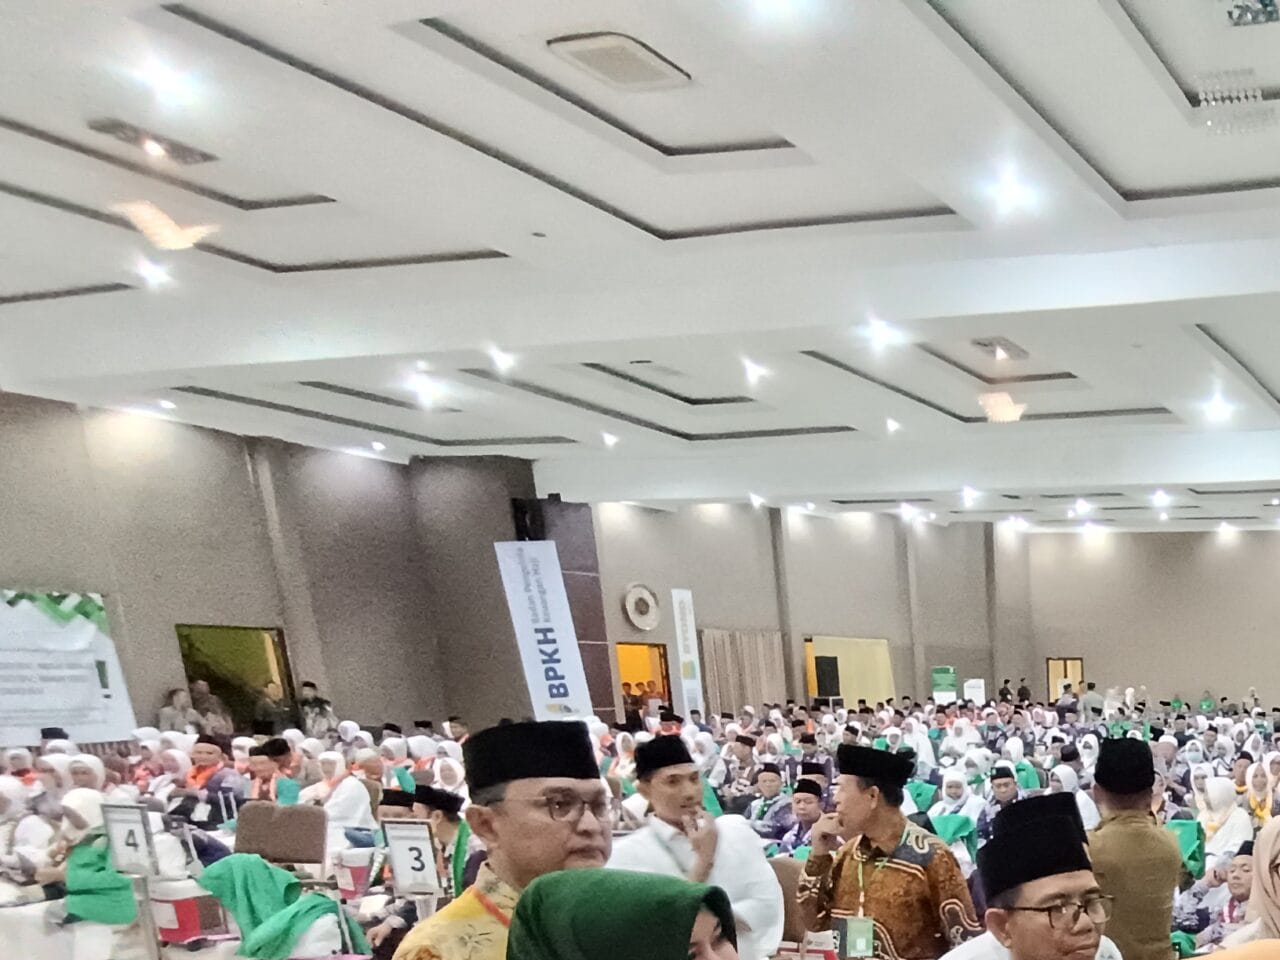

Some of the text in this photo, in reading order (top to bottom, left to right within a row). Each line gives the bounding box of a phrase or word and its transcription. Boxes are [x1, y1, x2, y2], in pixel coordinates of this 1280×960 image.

[533, 627, 569, 699] BPKH
[125, 829, 139, 852] 4
[408, 846, 426, 872] 3
